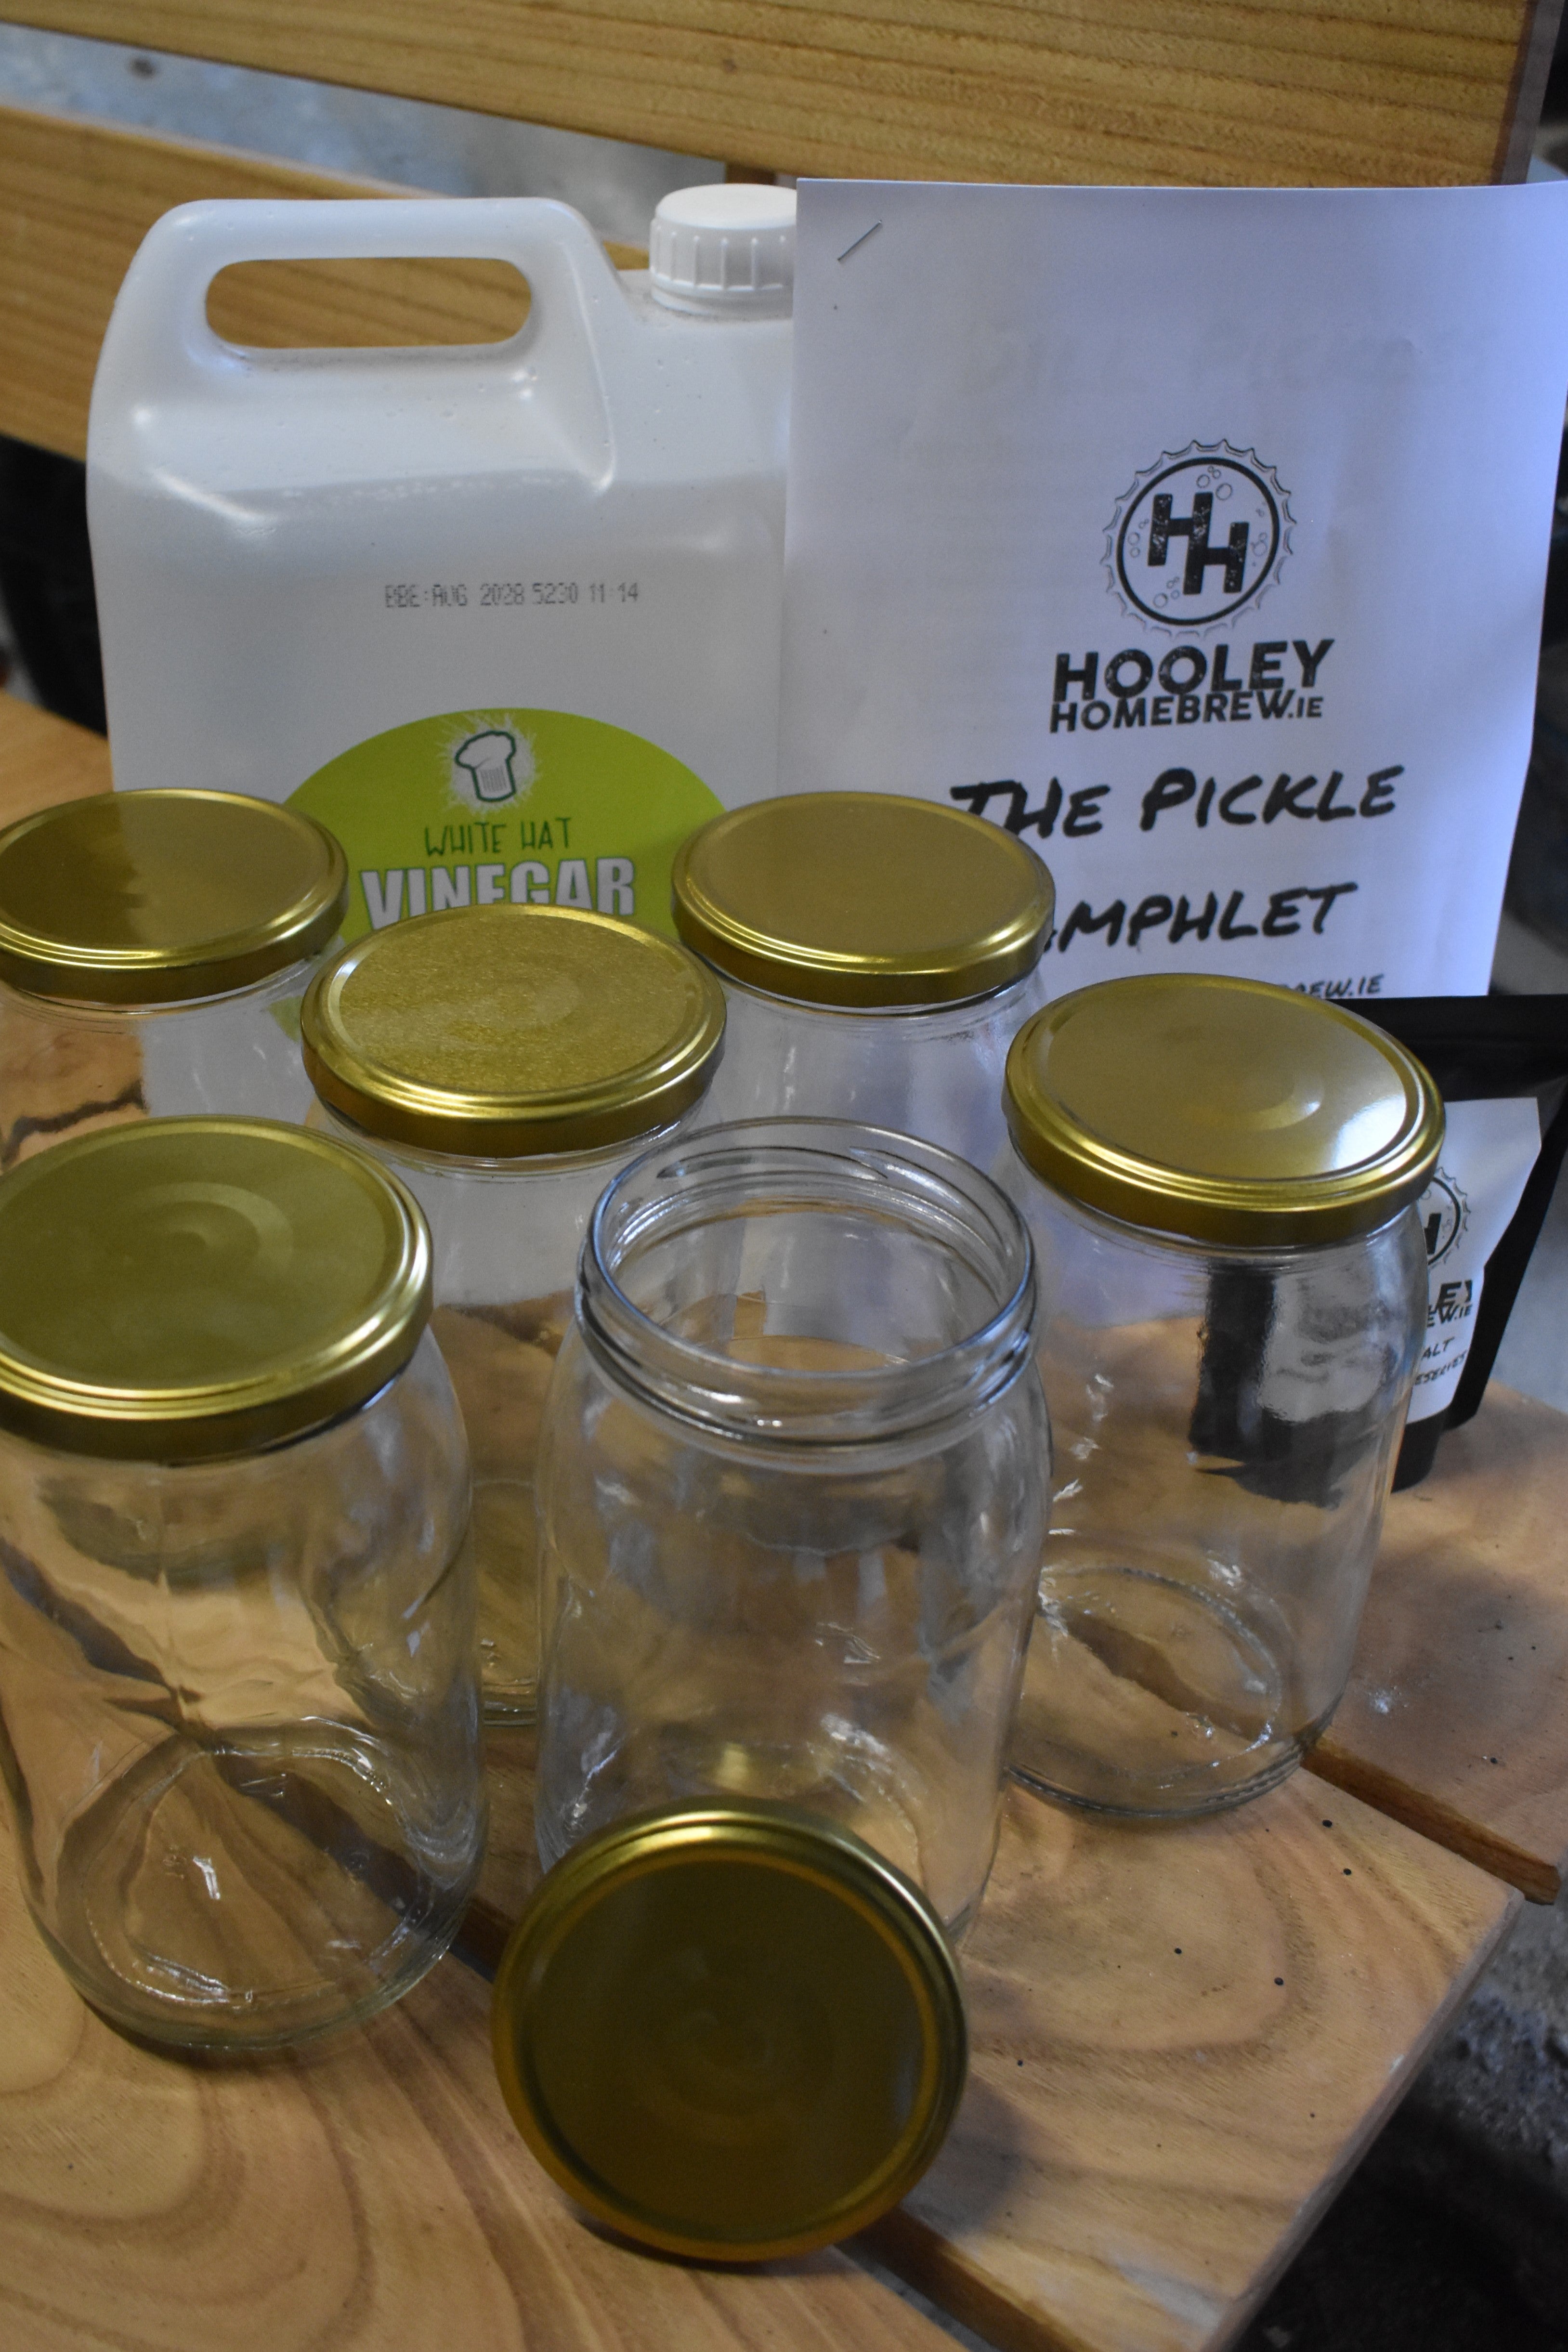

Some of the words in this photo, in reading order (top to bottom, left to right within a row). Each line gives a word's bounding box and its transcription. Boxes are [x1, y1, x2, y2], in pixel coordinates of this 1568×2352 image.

[1054, 639, 1335, 702] HOOLEY
[1049, 689, 1324, 733] HOMEBREW.IE
[950, 777, 1110, 838] THE
[1140, 765, 1404, 831] PICKLE
[424, 821, 507, 856] WHITE
[521, 817, 572, 849] HAT
[360, 856, 635, 931] VINEGAR
[1044, 882, 1358, 953] MPHLET
[1421, 1336, 1455, 1361] ALT
